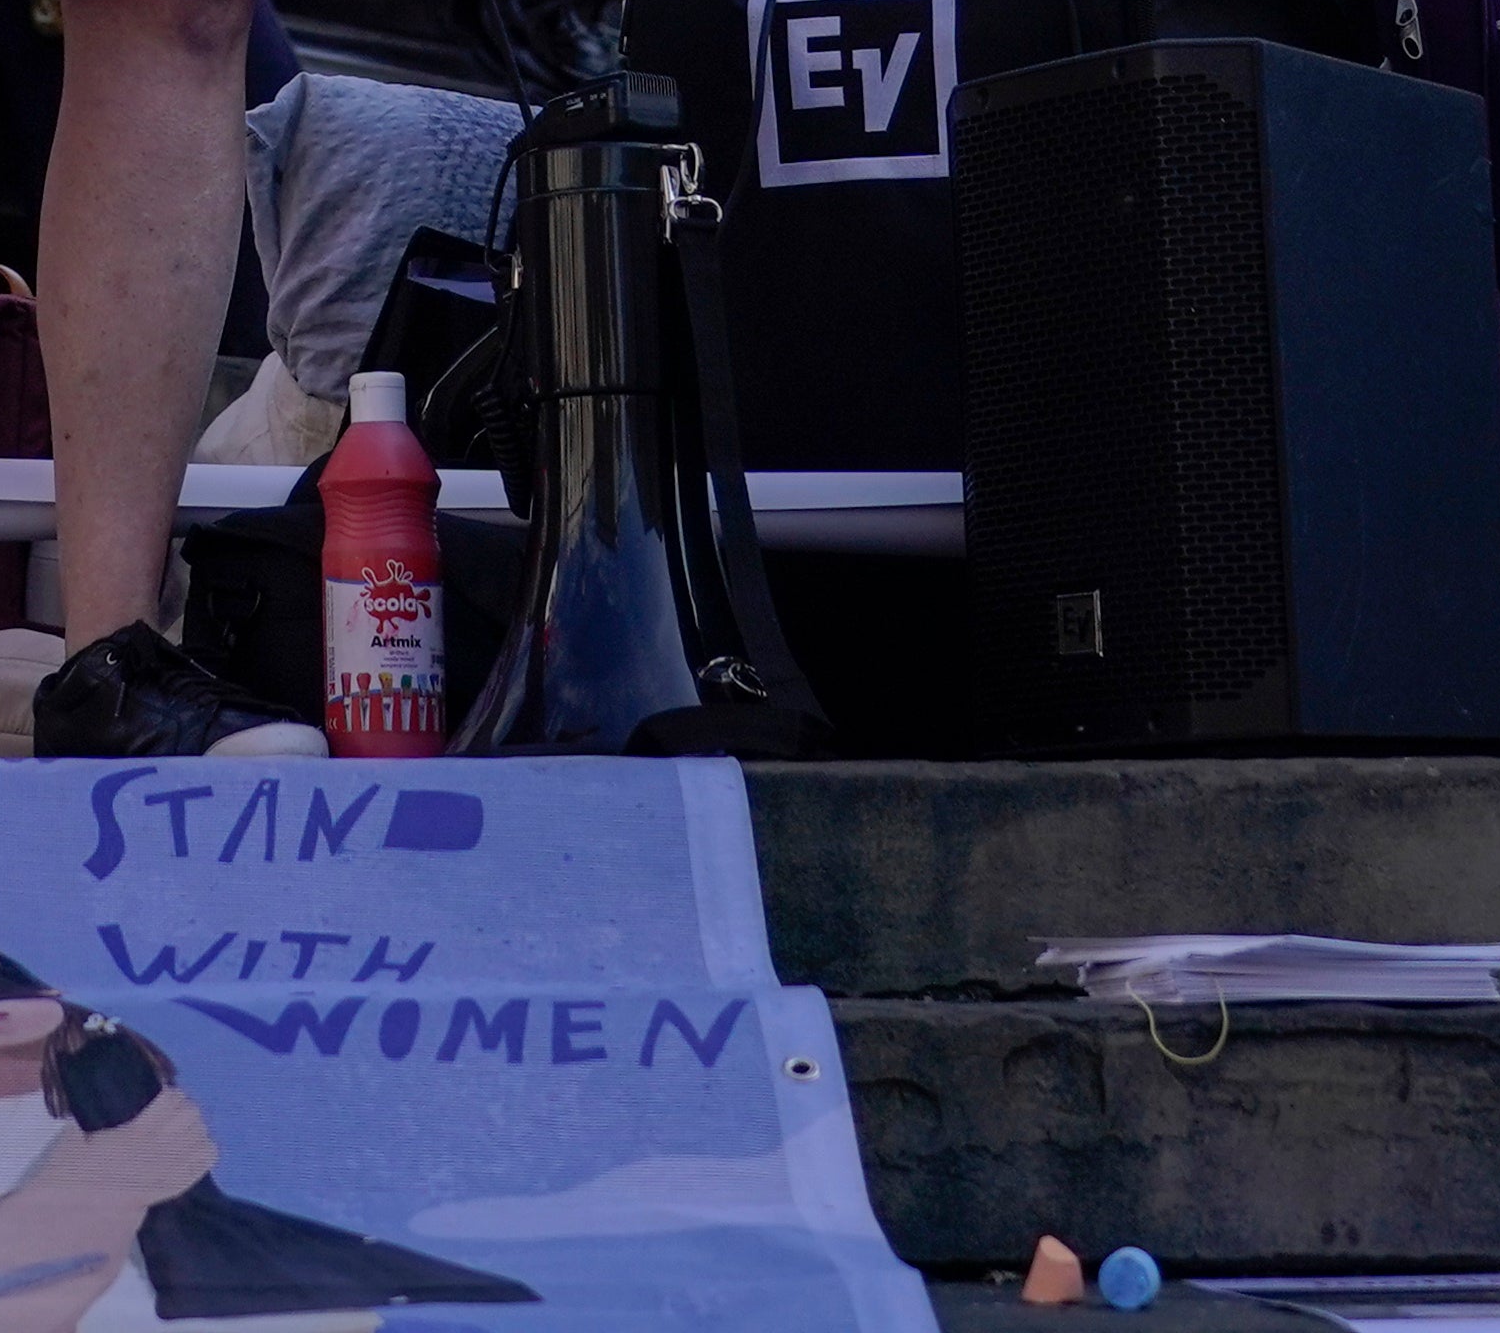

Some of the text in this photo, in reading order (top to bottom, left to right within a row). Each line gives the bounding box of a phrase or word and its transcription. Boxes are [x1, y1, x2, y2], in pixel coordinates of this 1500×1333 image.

[364, 592, 418, 613] scola
[371, 634, 422, 649] Artmix
[86, 765, 484, 881] STAND
[98, 923, 434, 984] WITH
[173, 996, 750, 1067] WOMEN
